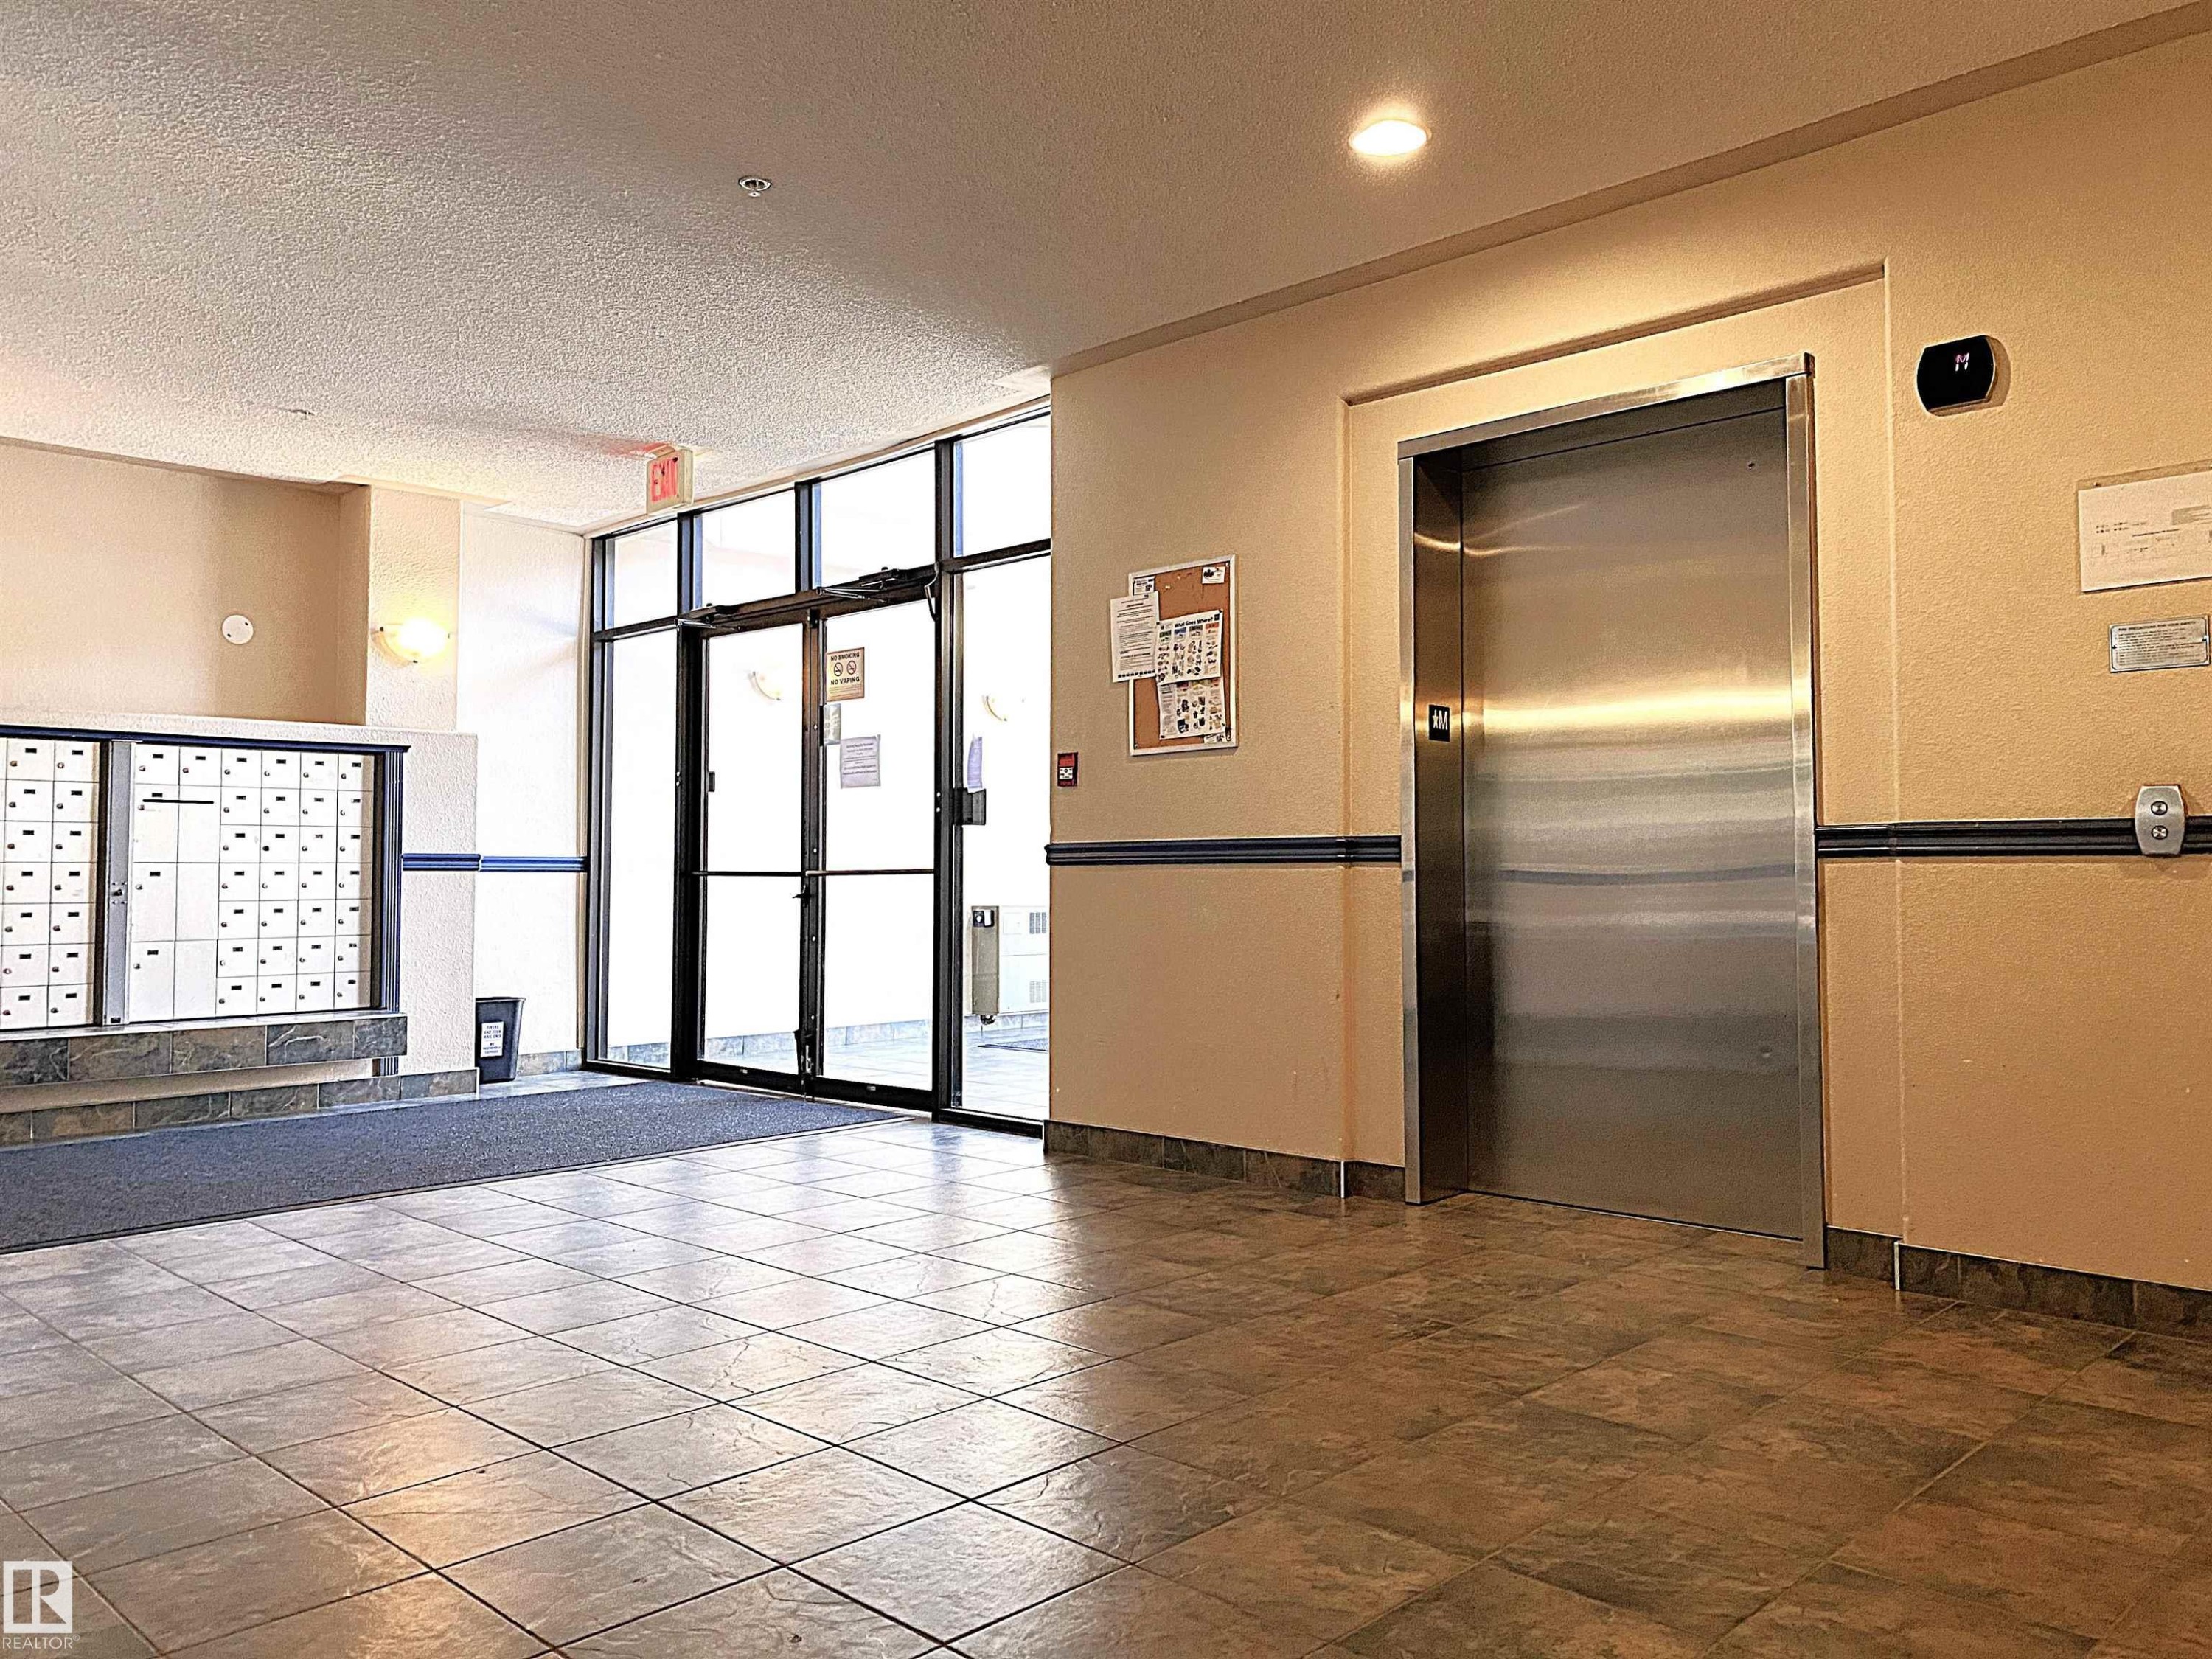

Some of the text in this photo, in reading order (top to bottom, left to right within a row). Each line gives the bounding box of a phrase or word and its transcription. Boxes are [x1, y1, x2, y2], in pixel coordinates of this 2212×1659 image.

[1955, 352, 1970, 372] M
[651, 458, 678, 502] EXIT
[838, 652, 860, 661] SMOKING
[839, 676, 860, 684] VAPING
[1439, 709, 1448, 731] M
